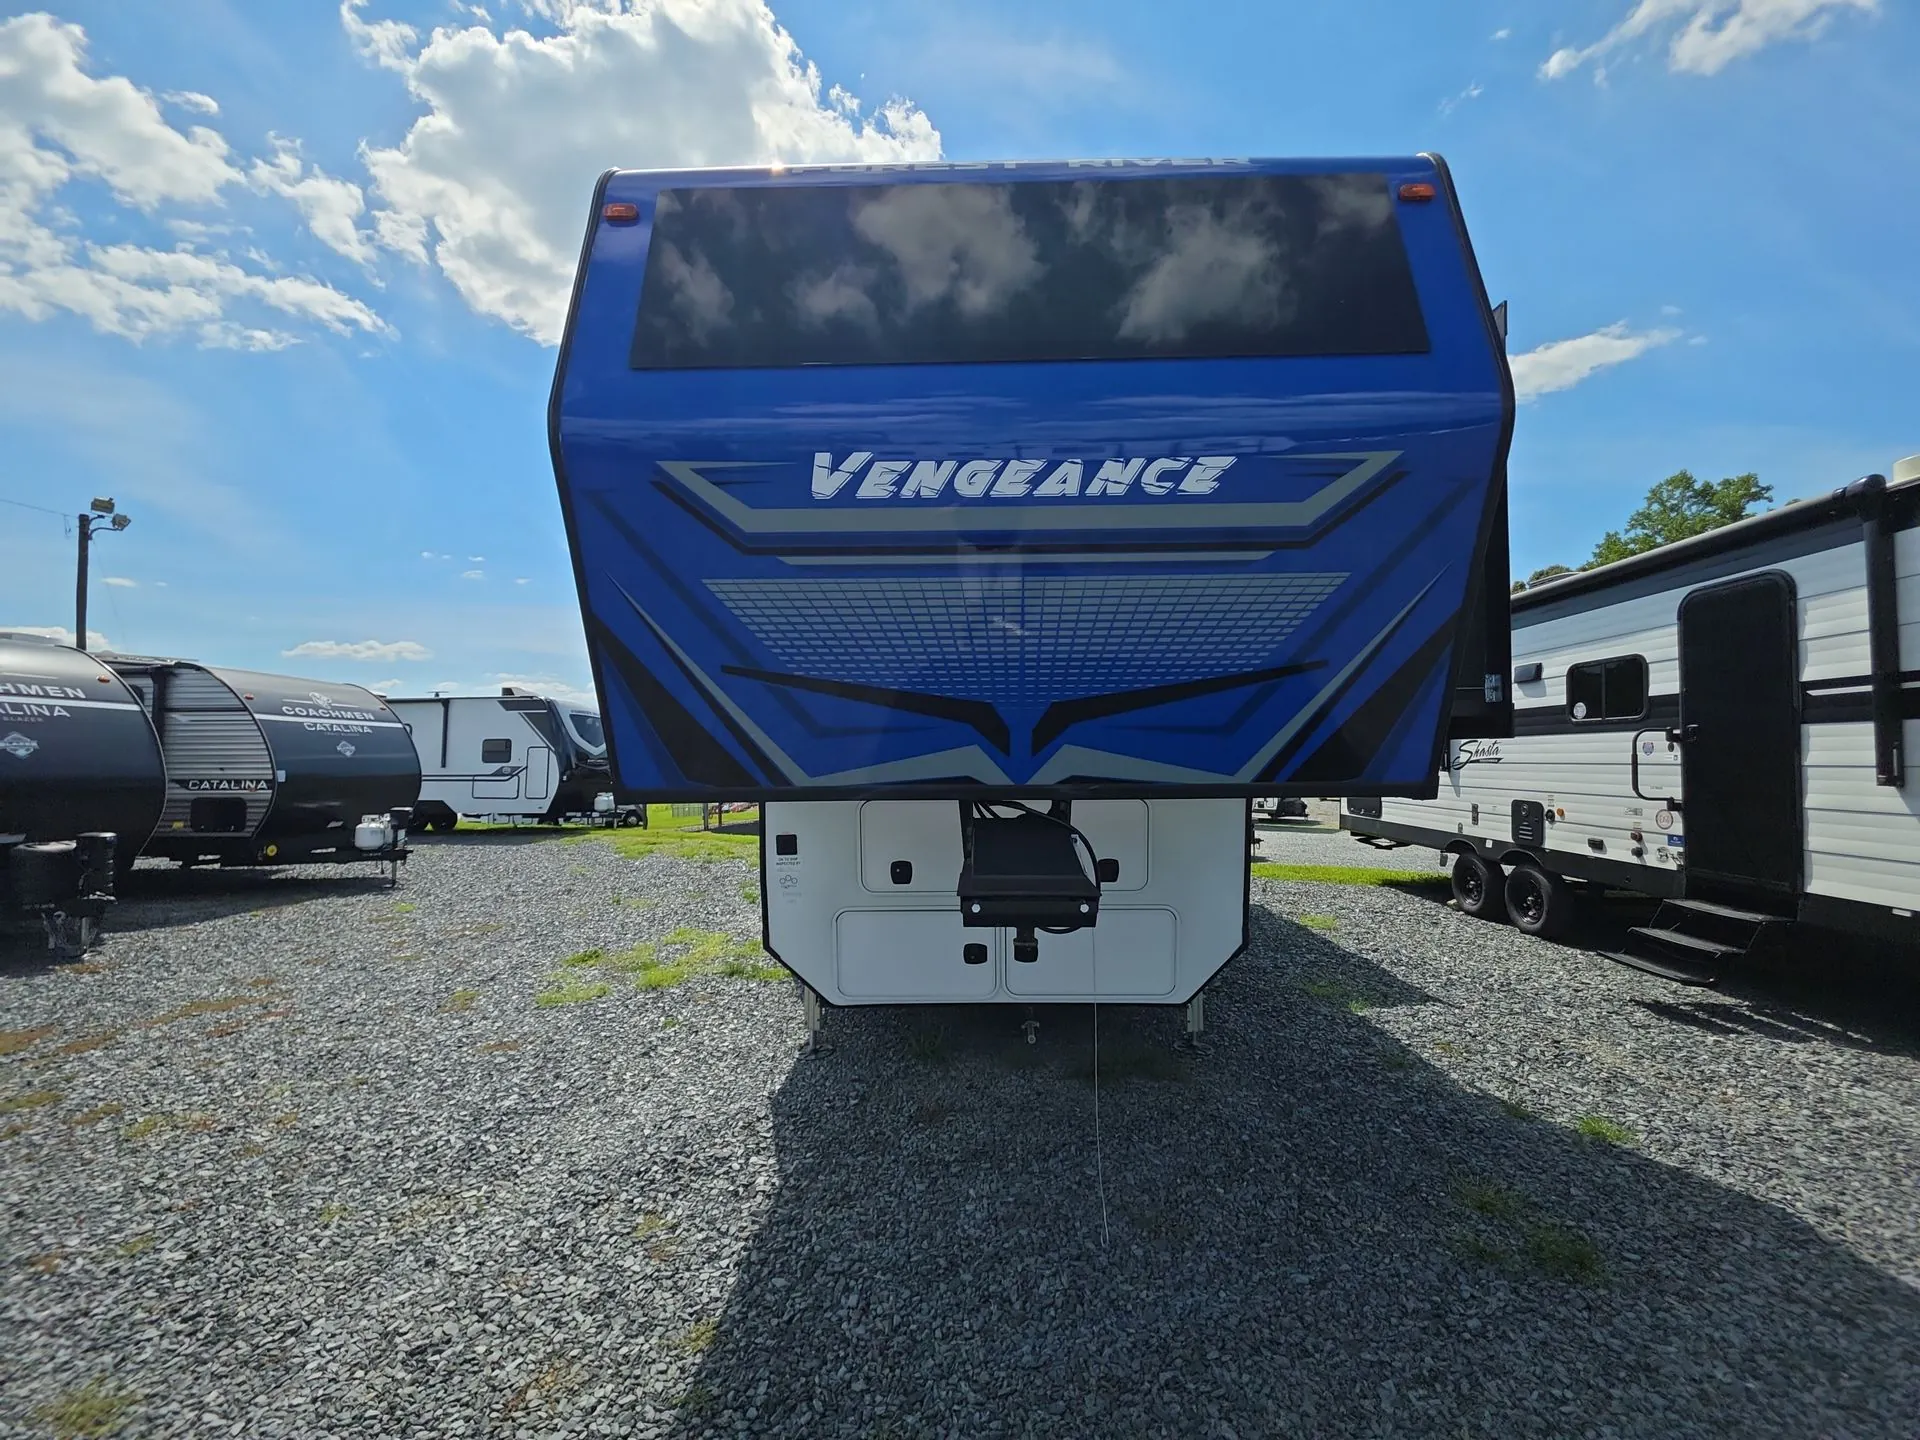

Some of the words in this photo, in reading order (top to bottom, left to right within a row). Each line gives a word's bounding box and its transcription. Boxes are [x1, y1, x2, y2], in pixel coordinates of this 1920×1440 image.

[811, 451, 1237, 499] VENGEANCE
[0, 703, 71, 718] LINA
[282, 706, 375, 720] COACHMEN
[303, 722, 373, 734] CATALINA
[1452, 740, 1502, 770] Shasta
[188, 780, 268, 790] CATALINA
